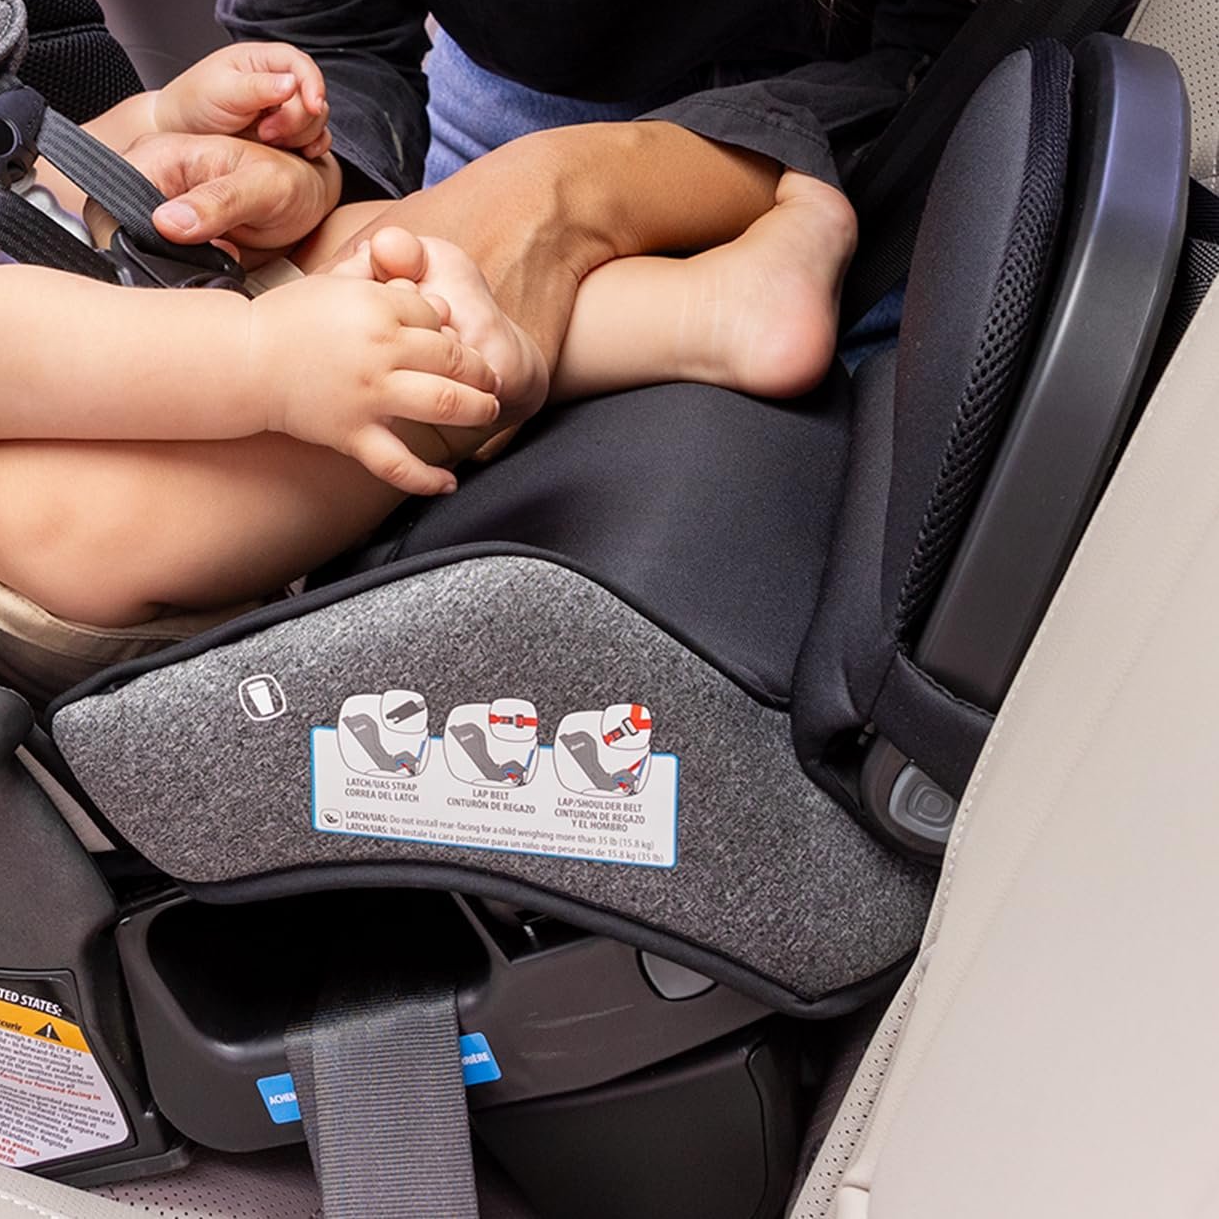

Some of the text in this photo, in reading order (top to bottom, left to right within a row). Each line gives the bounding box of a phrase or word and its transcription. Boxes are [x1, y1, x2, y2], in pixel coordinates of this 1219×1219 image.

[346, 778, 417, 791] LATCH/UAS STRAP
[344, 788, 419, 802] CORREA DEL LATCH
[472, 789, 508, 800] LAP BELT
[446, 796, 536, 813] CINTURÓN DE REGAZO
[557, 797, 641, 812] LAP/SHOULDER BELT
[554, 807, 645, 823] CINTURÓN DE REGAZO
[345, 810, 387, 822] LATCH/UAS:
[389, 814, 400, 823] Do
[401, 816, 413, 825] not
[415, 817, 437, 827] install
[439, 819, 480, 833] rear-facing
[481, 823, 491, 833] for
[498, 826, 516, 836] child
[517, 828, 553, 840] weighing
[555, 833, 575, 841] more
[577, 834, 596, 843] than
[598, 836, 607, 844] 35
[609, 837, 616, 845] lb
[641, 839, 653, 850] kg)
[571, 819, 628, 832] Y EL HOMBRO
[345, 822, 388, 834] LATCH/UAS:
[390, 826, 400, 835] No
[402, 827, 427, 838] instale
[438, 832, 453, 840] cara
[455, 833, 489, 845] posterior
[491, 837, 508, 847] para
[541, 844, 555, 852] que
[557, 845, 575, 854] pese
[595, 847, 604, 856] de
[607, 849, 624, 858] 15.8
[625, 851, 635, 860] kg
[637, 852, 650, 862] (35
[651, 853, 663, 863] lb)
[20, 995, 63, 1017] STATES:
